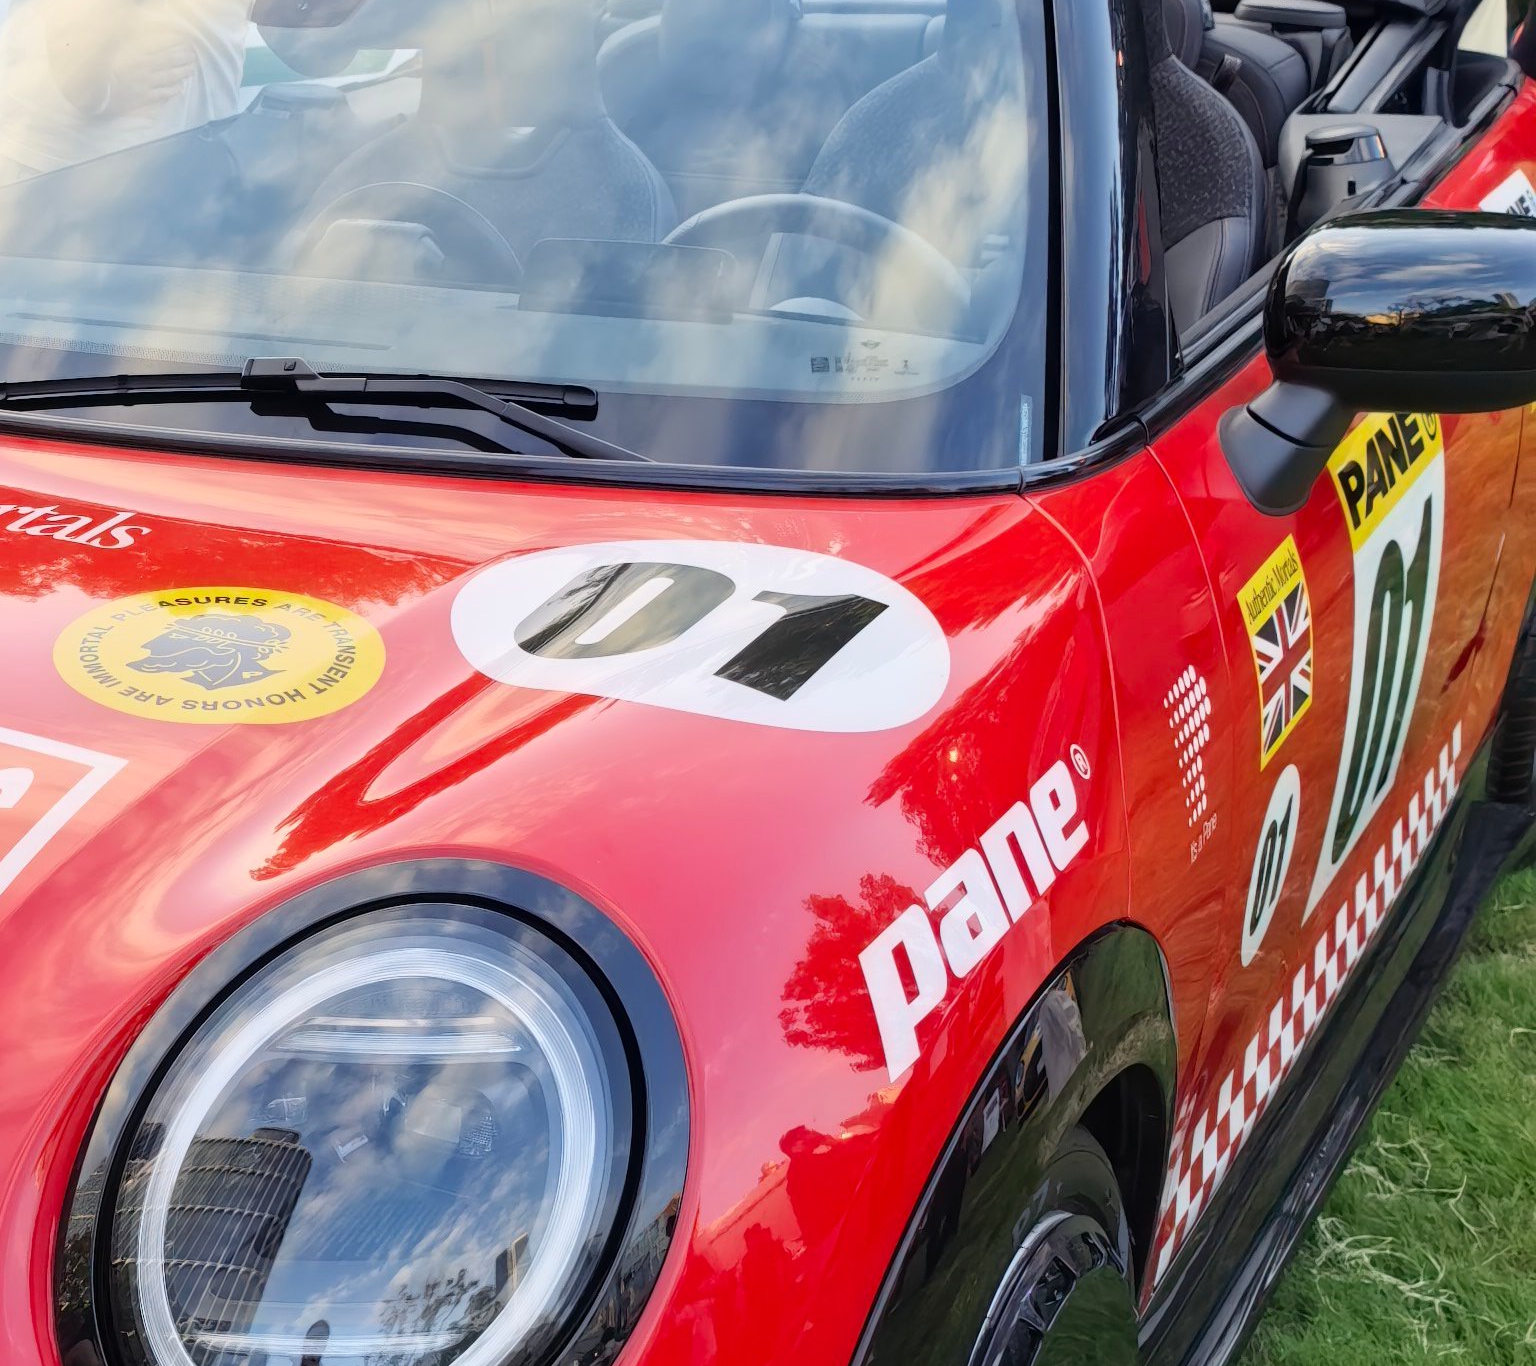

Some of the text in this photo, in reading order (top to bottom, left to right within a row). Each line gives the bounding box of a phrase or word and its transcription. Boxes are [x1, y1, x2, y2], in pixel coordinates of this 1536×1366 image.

[80, 596, 357, 712] PLEASURES ARE TRANSIENT HONORS ARE IMMORTAL
[514, 561, 890, 702] 01
[1332, 490, 1432, 865] 01
[1249, 793, 1294, 938] 01
